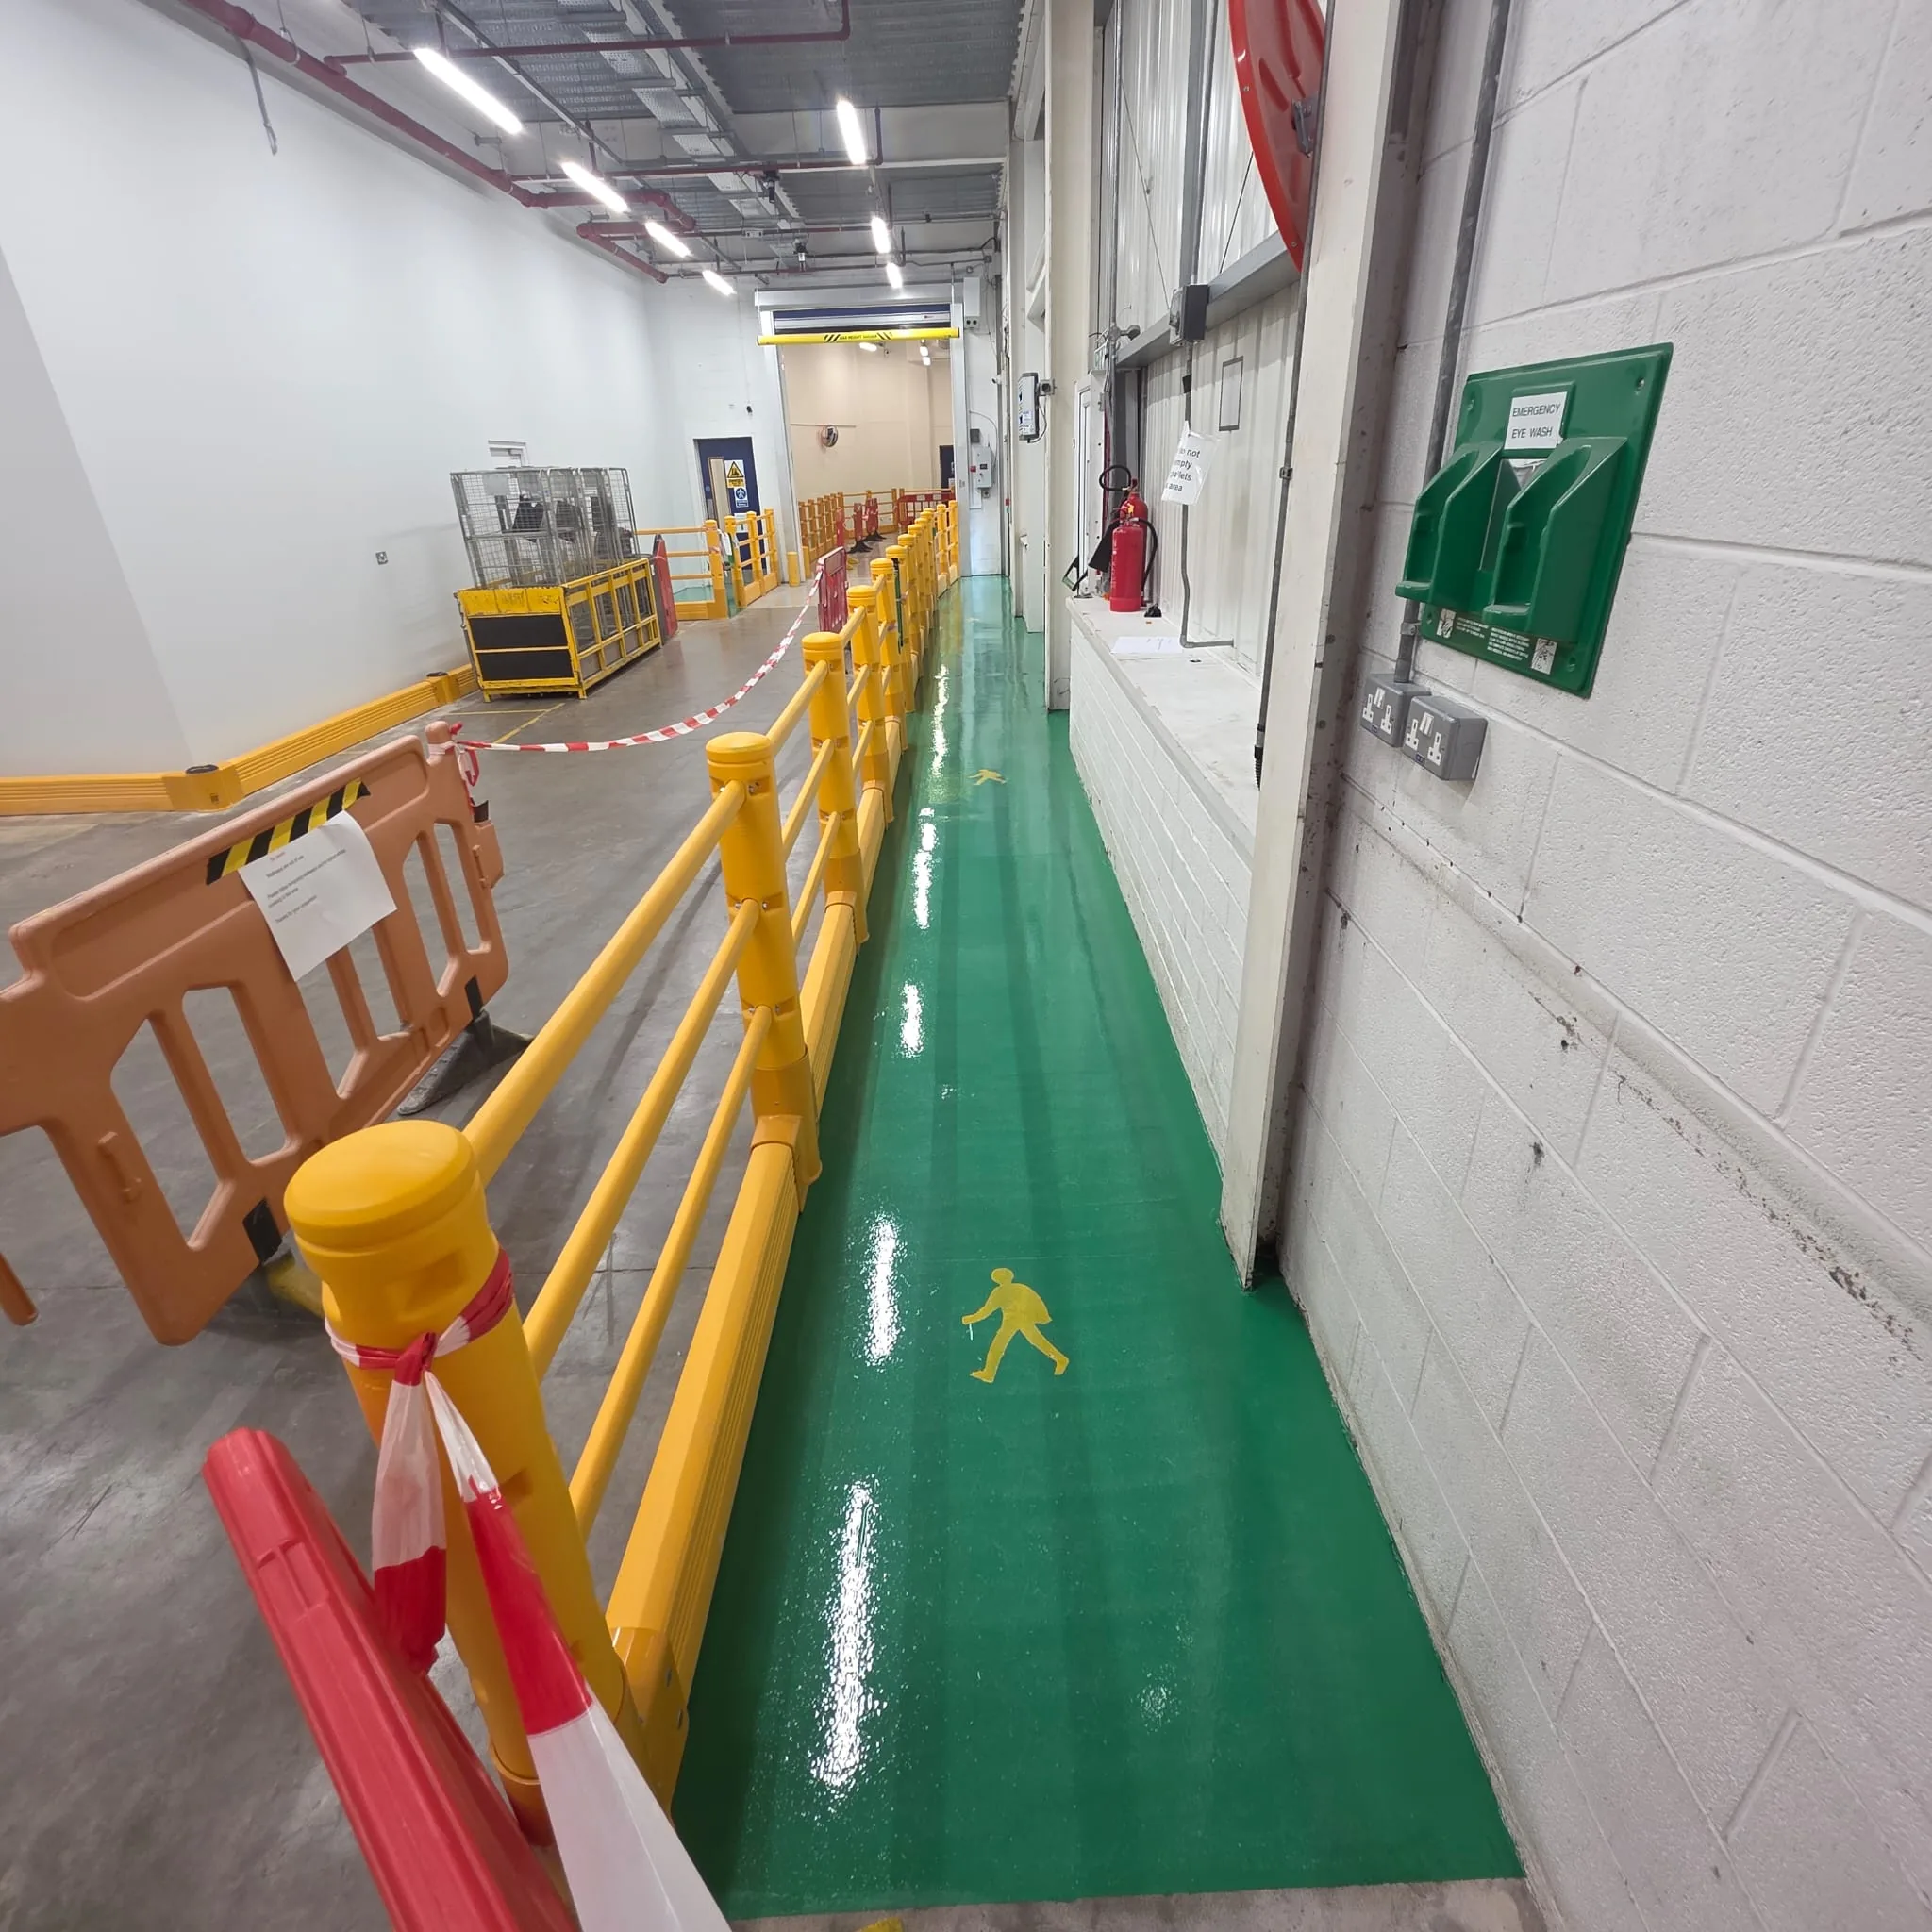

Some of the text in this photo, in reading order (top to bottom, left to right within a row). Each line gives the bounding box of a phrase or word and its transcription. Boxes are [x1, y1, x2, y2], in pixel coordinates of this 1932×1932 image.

[1512, 403, 1561, 417] EMERGENCY
[1511, 426, 1553, 439] EYE WASH
[1187, 448, 1201, 458] not
[1169, 483, 1183, 491] area
